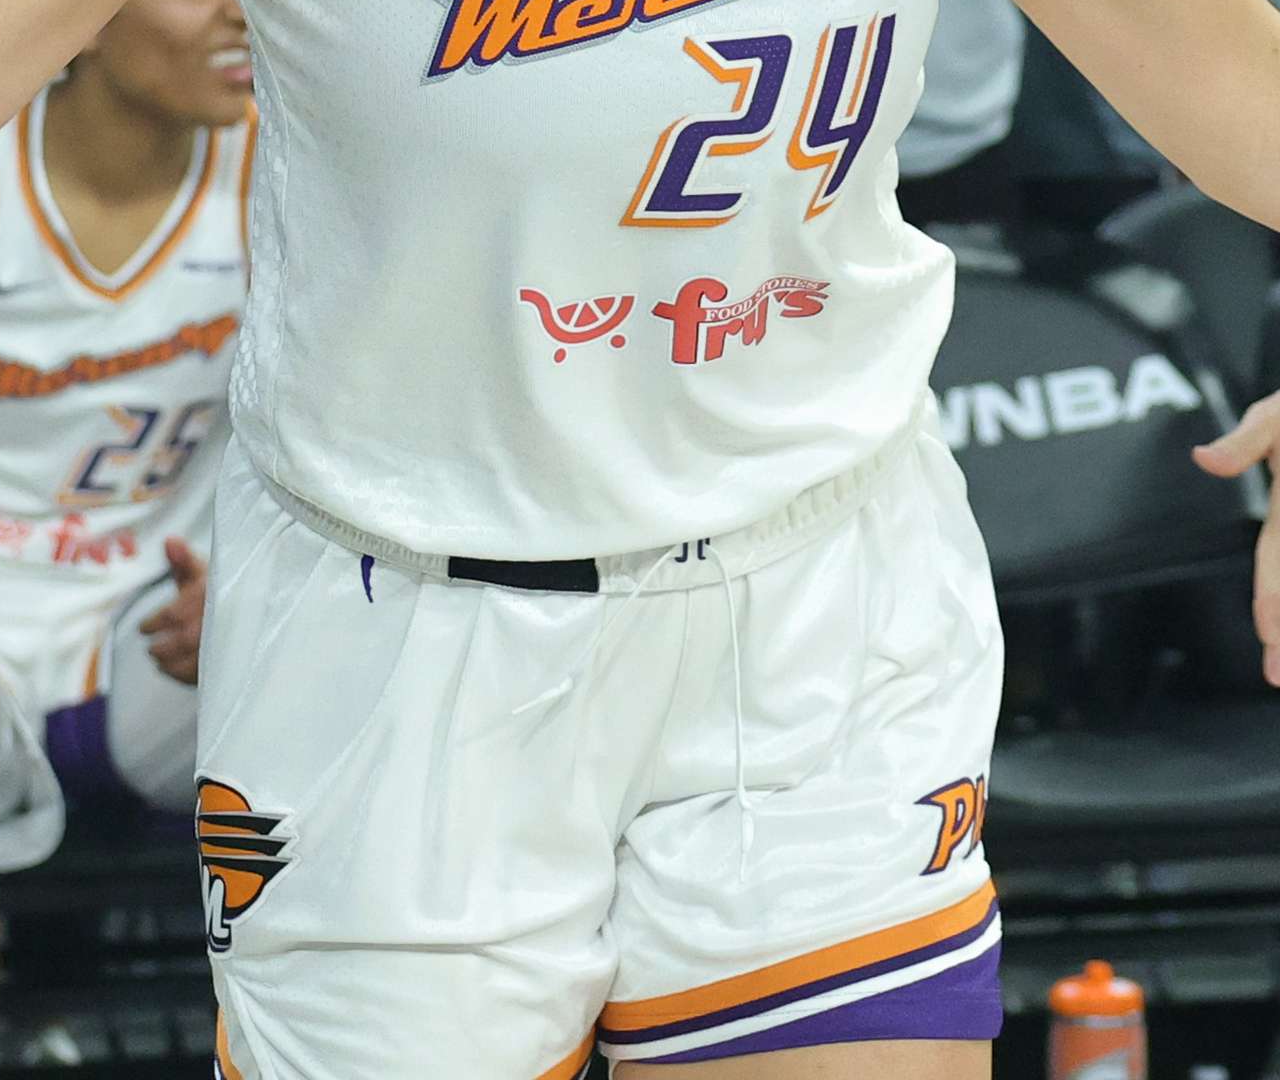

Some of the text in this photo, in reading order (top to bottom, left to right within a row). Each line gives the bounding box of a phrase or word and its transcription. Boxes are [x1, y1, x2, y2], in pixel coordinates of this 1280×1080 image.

[618, 12, 897, 228] 24
[705, 297, 754, 322] FOOD
[754, 277, 819, 302] STORES
[56, 400, 220, 507] 25
